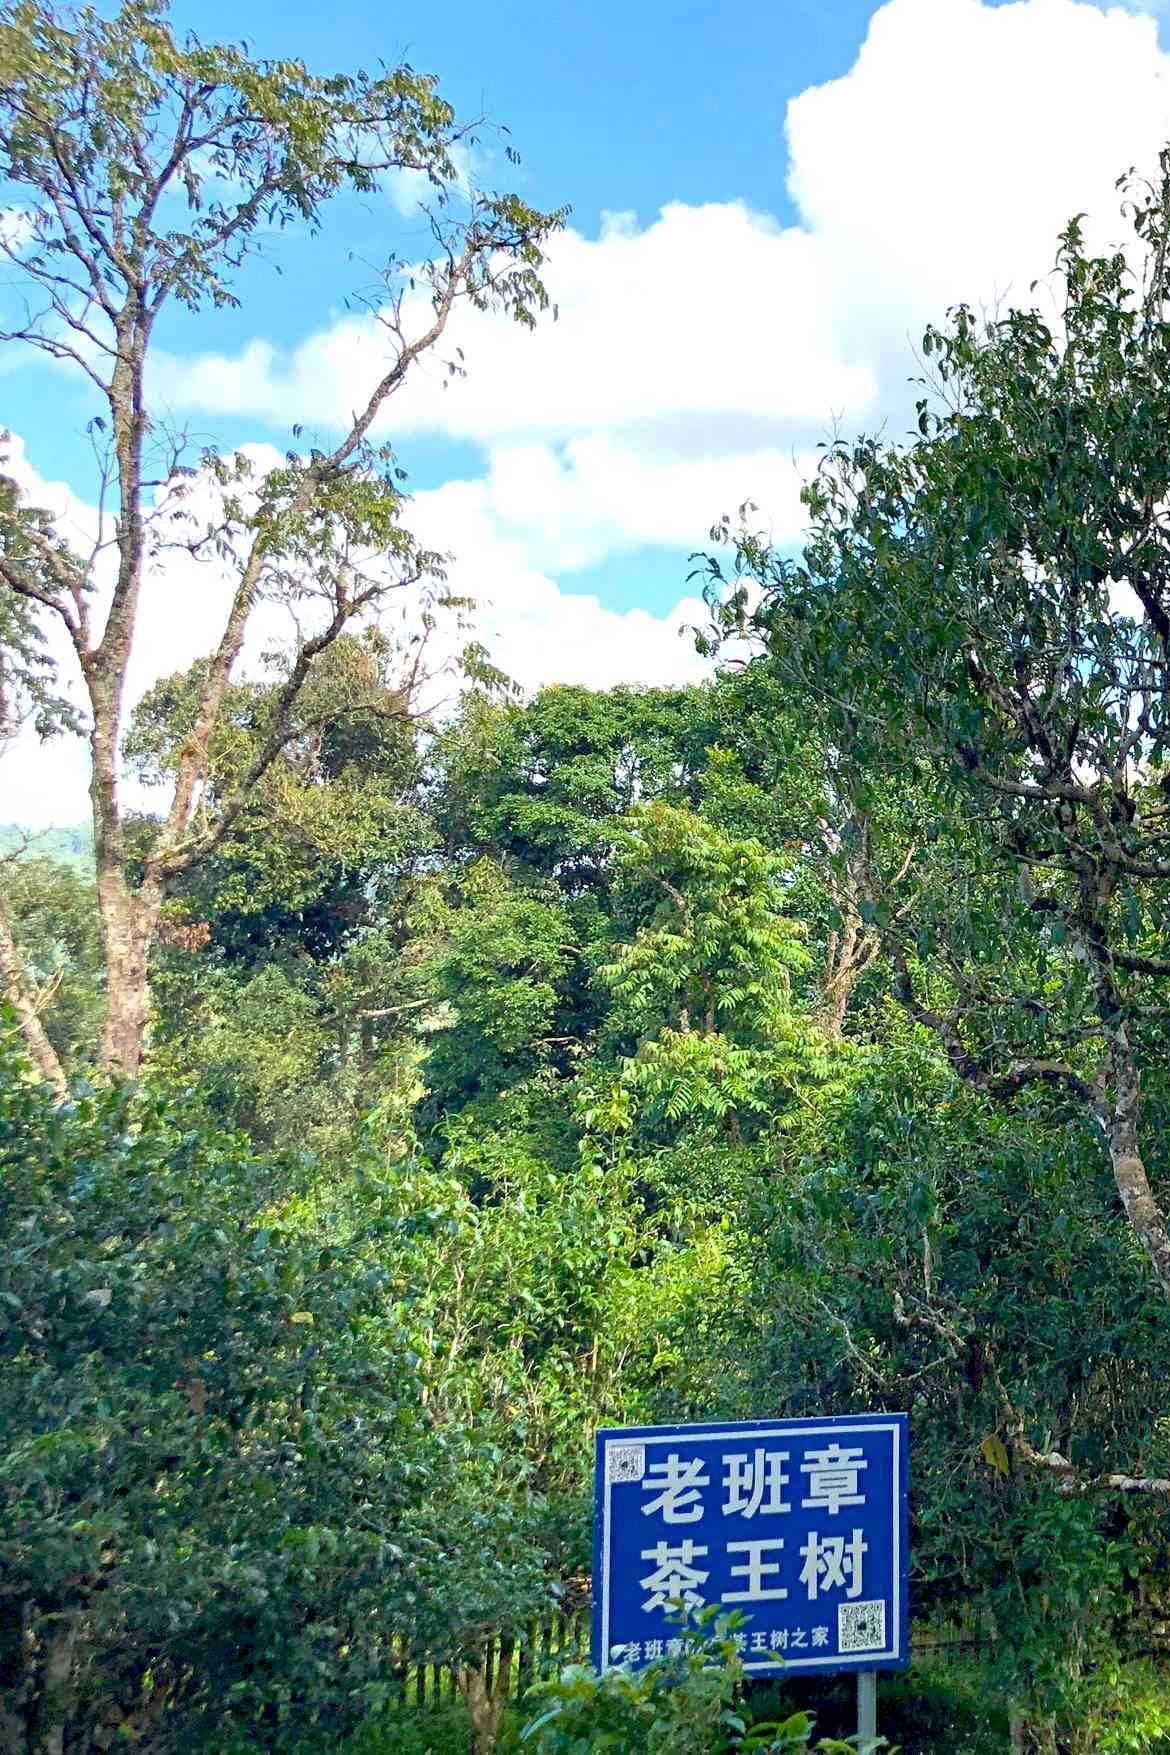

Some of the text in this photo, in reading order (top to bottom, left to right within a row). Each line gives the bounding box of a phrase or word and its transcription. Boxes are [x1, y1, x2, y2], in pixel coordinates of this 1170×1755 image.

[640, 1443, 868, 1524] 老班章
[640, 1528, 868, 1613] 茶王树
